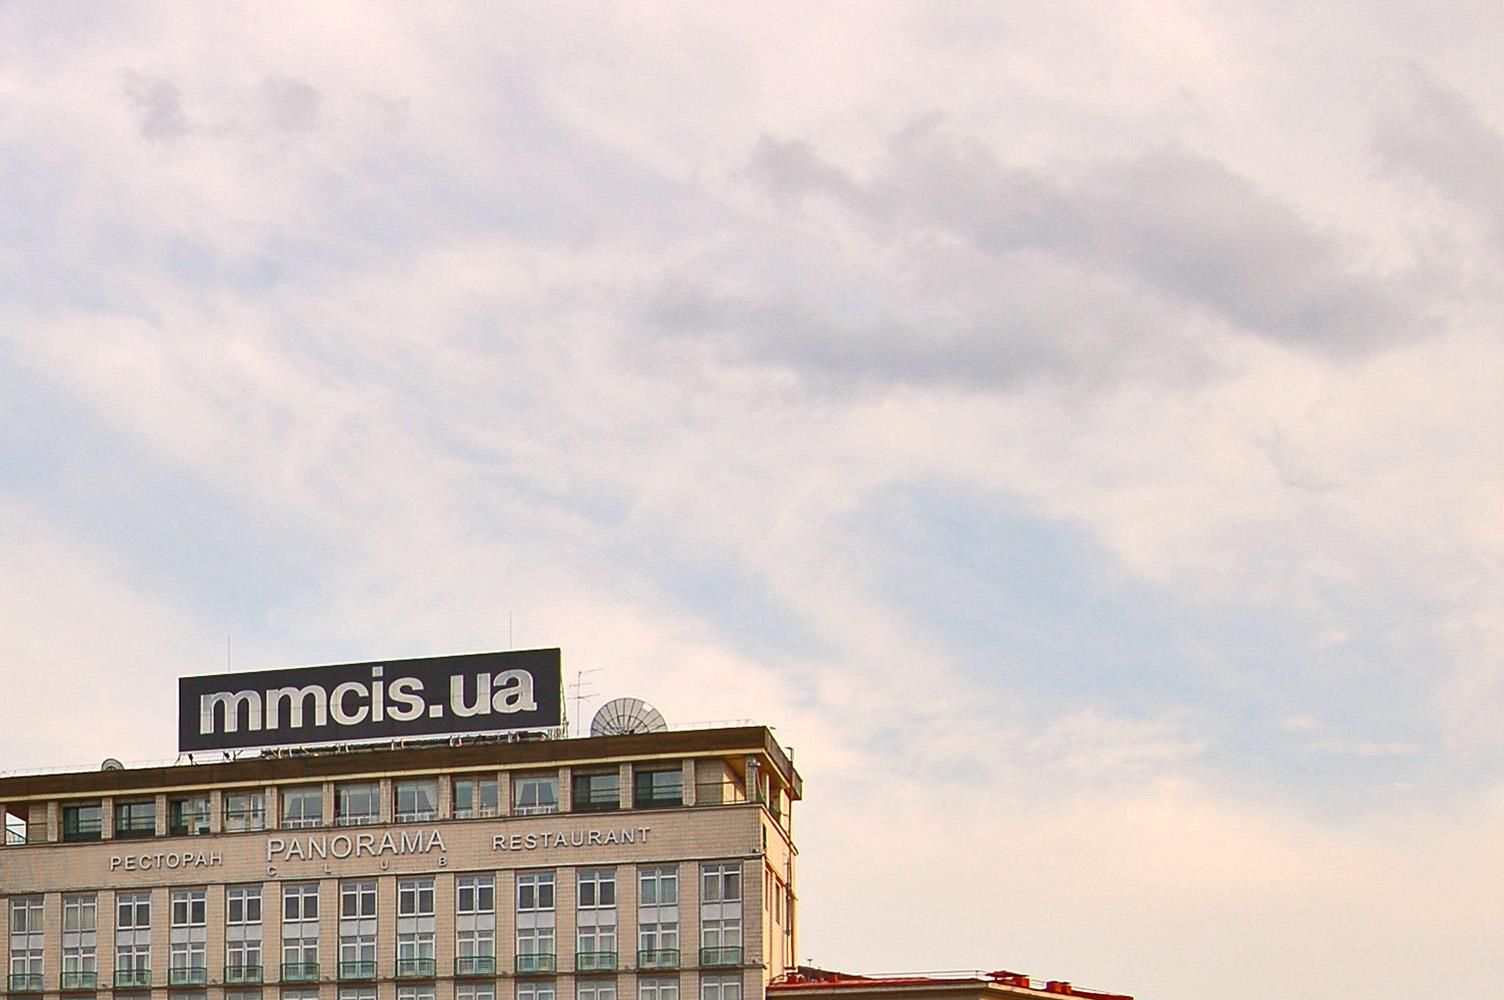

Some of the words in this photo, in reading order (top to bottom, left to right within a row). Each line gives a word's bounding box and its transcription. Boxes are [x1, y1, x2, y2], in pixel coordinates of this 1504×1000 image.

[199, 666, 538, 735] mmcis.ua
[266, 828, 447, 862] PANORAMA
[492, 826, 651, 851] RESTAURANT
[110, 850, 223, 871] РЕСТОРАН
